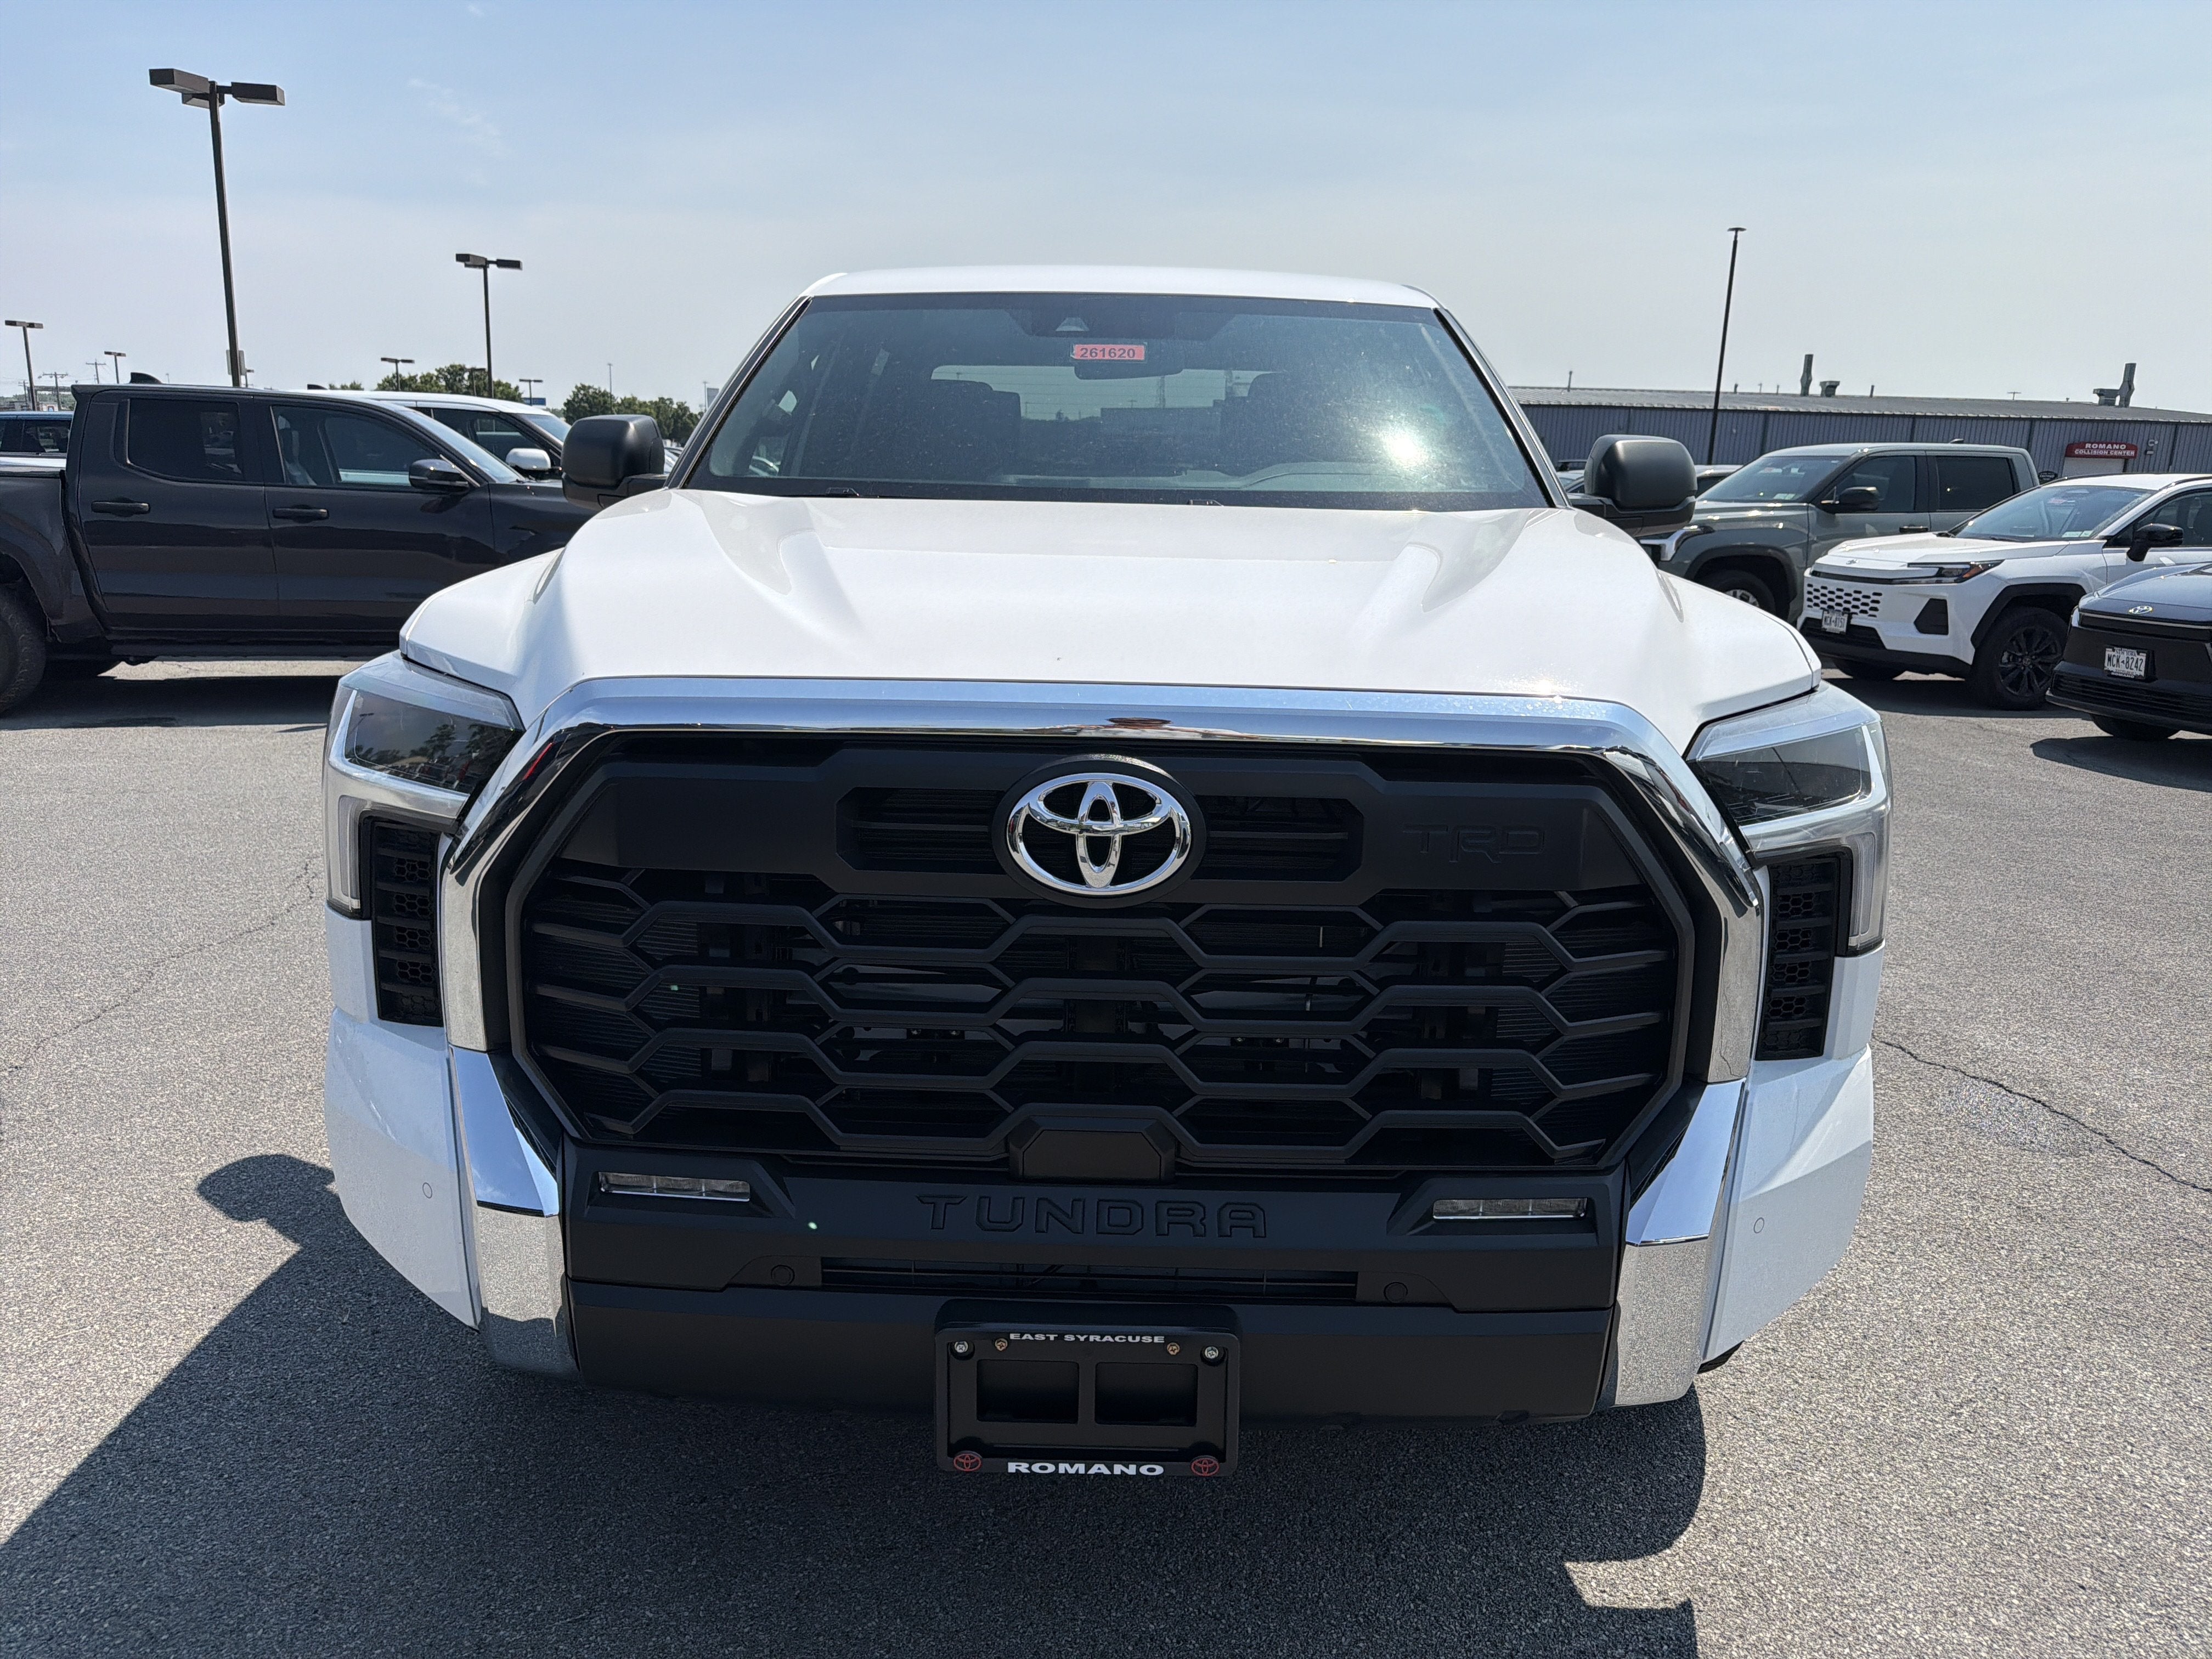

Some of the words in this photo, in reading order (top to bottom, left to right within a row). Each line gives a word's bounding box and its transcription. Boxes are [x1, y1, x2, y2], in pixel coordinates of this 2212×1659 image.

[1080, 347, 1136, 358] 261620
[1402, 825, 1545, 863] TRD
[916, 1194, 1267, 1238] TUNDRA
[1009, 1333, 1058, 1341] EAST
[1064, 1334, 1165, 1344] SYRACUSE
[1007, 1462, 1165, 1476] ROMANO
